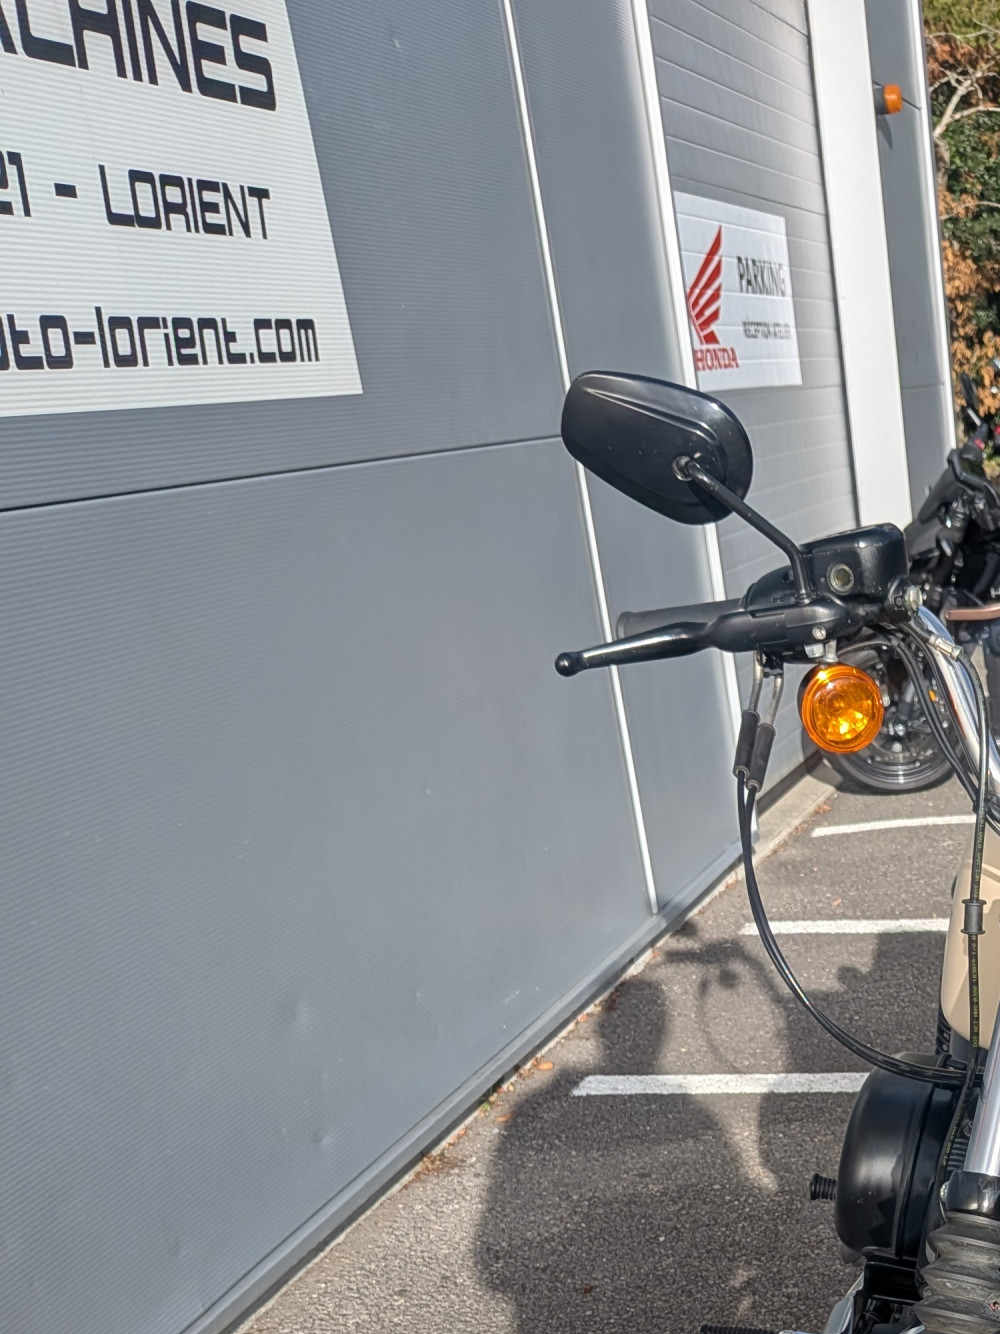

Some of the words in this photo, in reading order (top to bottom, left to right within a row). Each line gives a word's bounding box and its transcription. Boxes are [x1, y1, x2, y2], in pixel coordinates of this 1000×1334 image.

[98, 163, 271, 240] LORIENT
[736, 255, 788, 297] PARKING
[695, 347, 740, 372] HONDA
